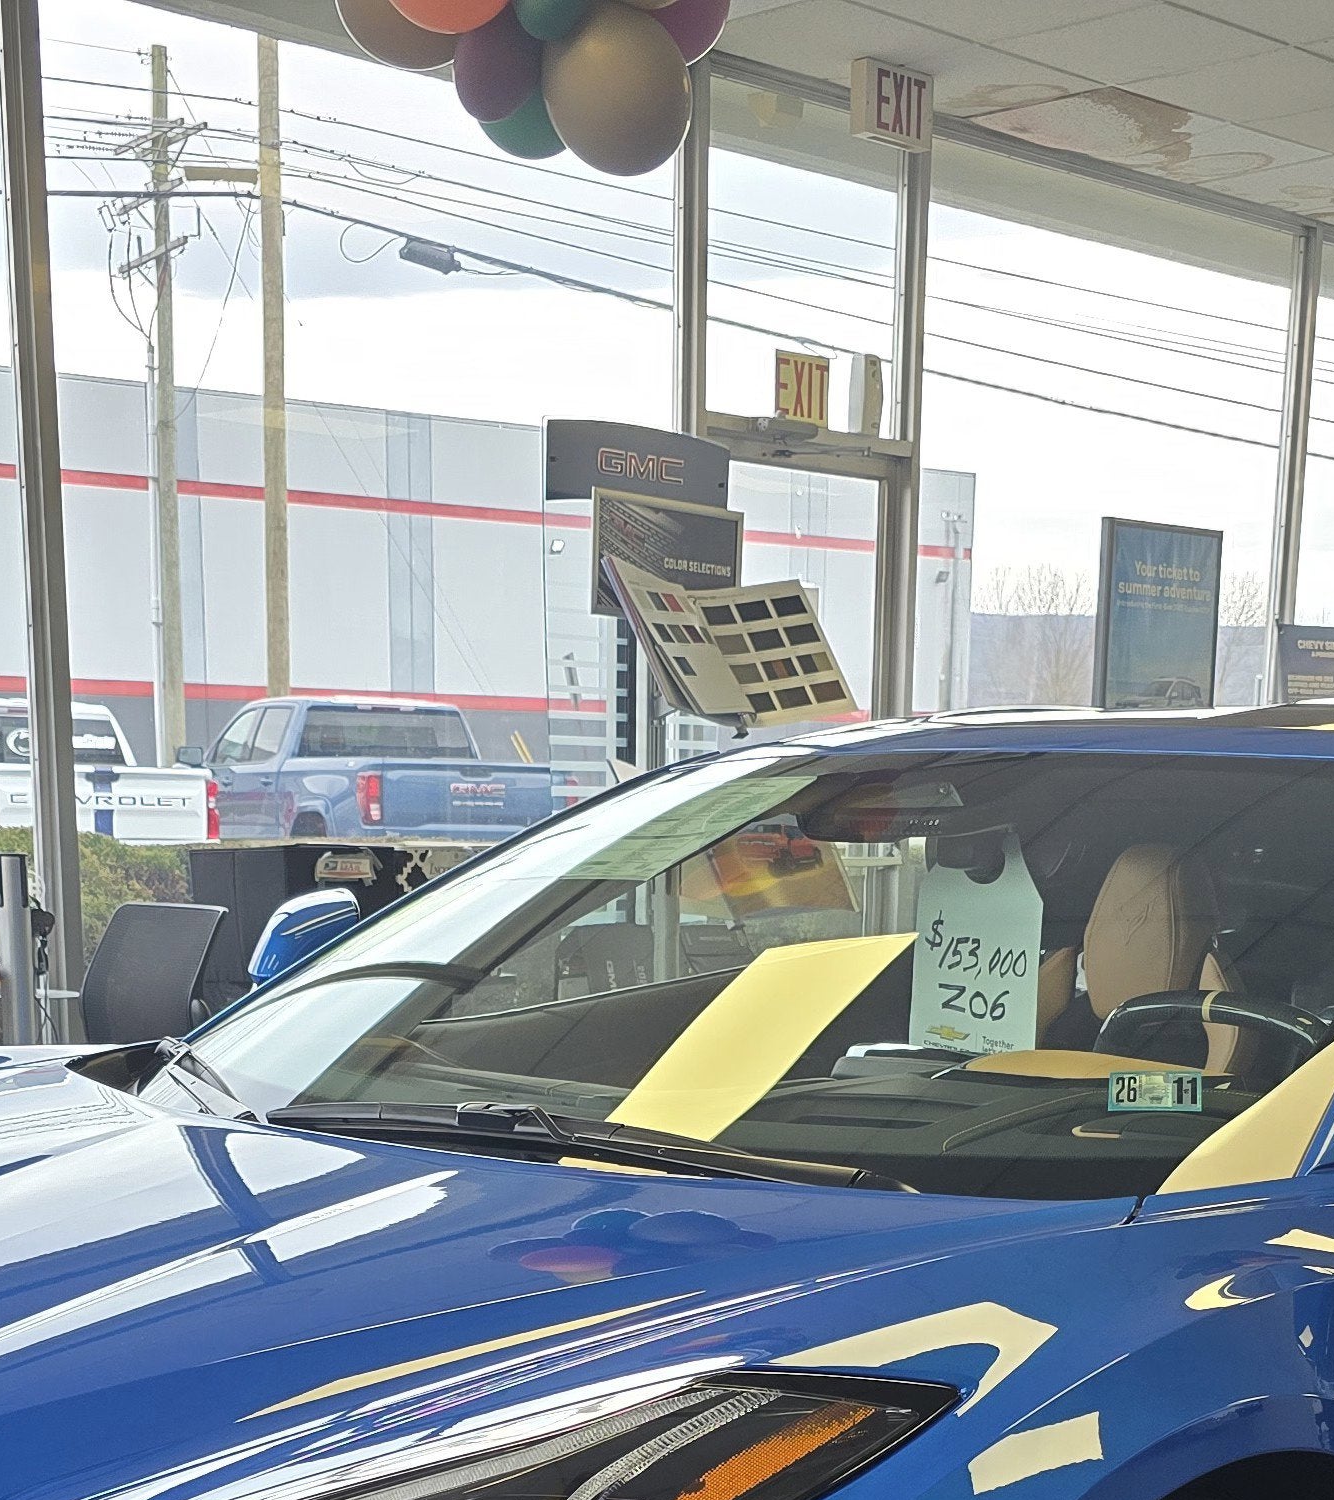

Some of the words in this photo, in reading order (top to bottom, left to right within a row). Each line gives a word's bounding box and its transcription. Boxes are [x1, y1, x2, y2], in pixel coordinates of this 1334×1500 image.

[876, 67, 927, 140] EXIT
[775, 357, 828, 421] EXIT
[597, 447, 685, 485] GMC
[664, 557, 689, 571] COLOR
[689, 561, 731, 577] SELECTIONS
[1134, 560, 1157, 577] Your
[1158, 563, 1187, 580] ticket
[1188, 567, 1201, 581] to
[1118, 581, 1162, 597] summer
[1163, 584, 1212, 601] adventure
[1297, 640, 1324, 650] CHEVY
[9, 793, 192, 807] CVROLET
[925, 910, 1027, 980] $153,000
[982, 1036, 1015, 1050] Together
[1115, 1076, 1137, 1103] 26
[1173, 1077, 1197, 1104] 11
